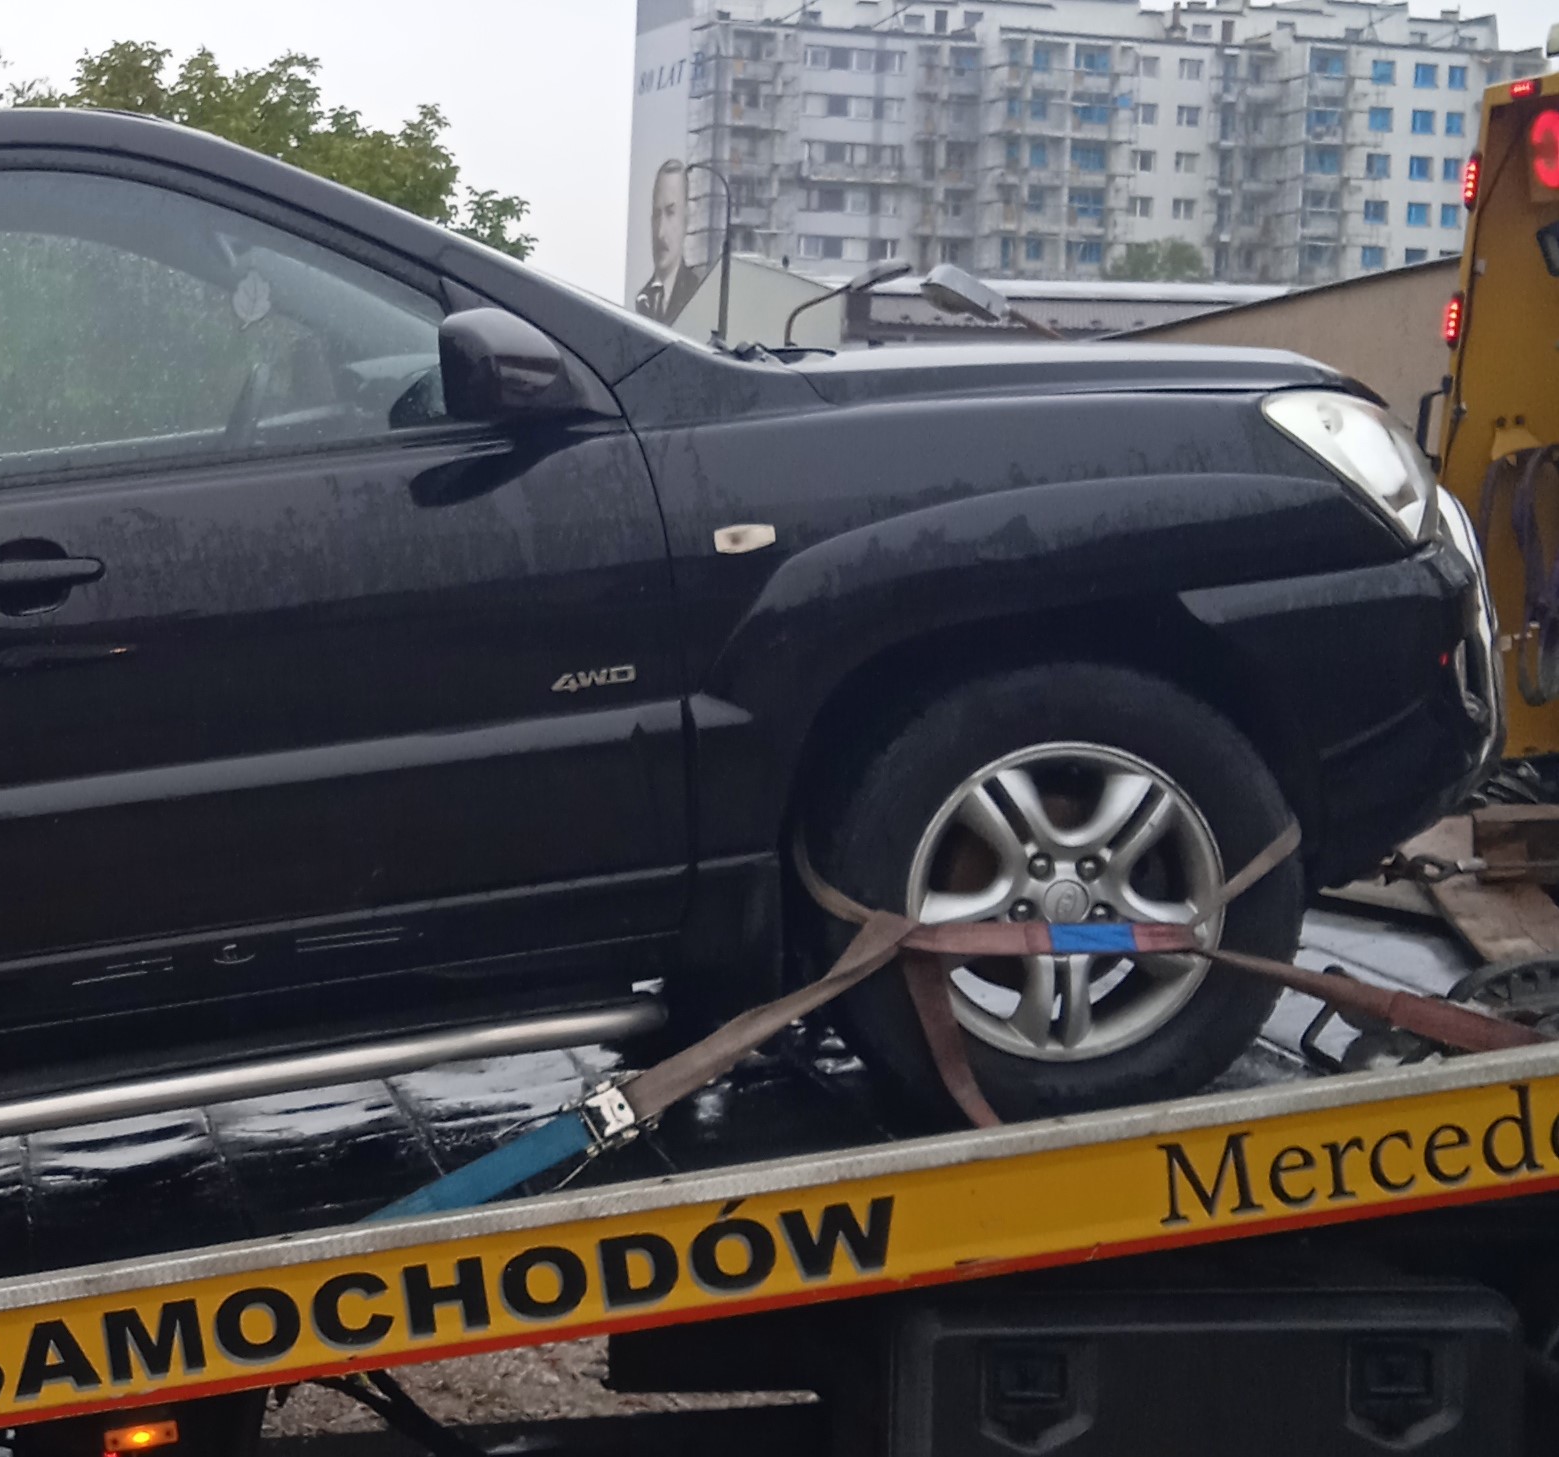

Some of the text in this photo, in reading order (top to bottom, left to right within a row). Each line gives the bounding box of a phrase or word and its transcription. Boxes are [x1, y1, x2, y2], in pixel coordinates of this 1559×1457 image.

[656, 58, 687, 91] LAT
[550, 663, 637, 693] 4WD
[1157, 1084, 1559, 1226] Merced
